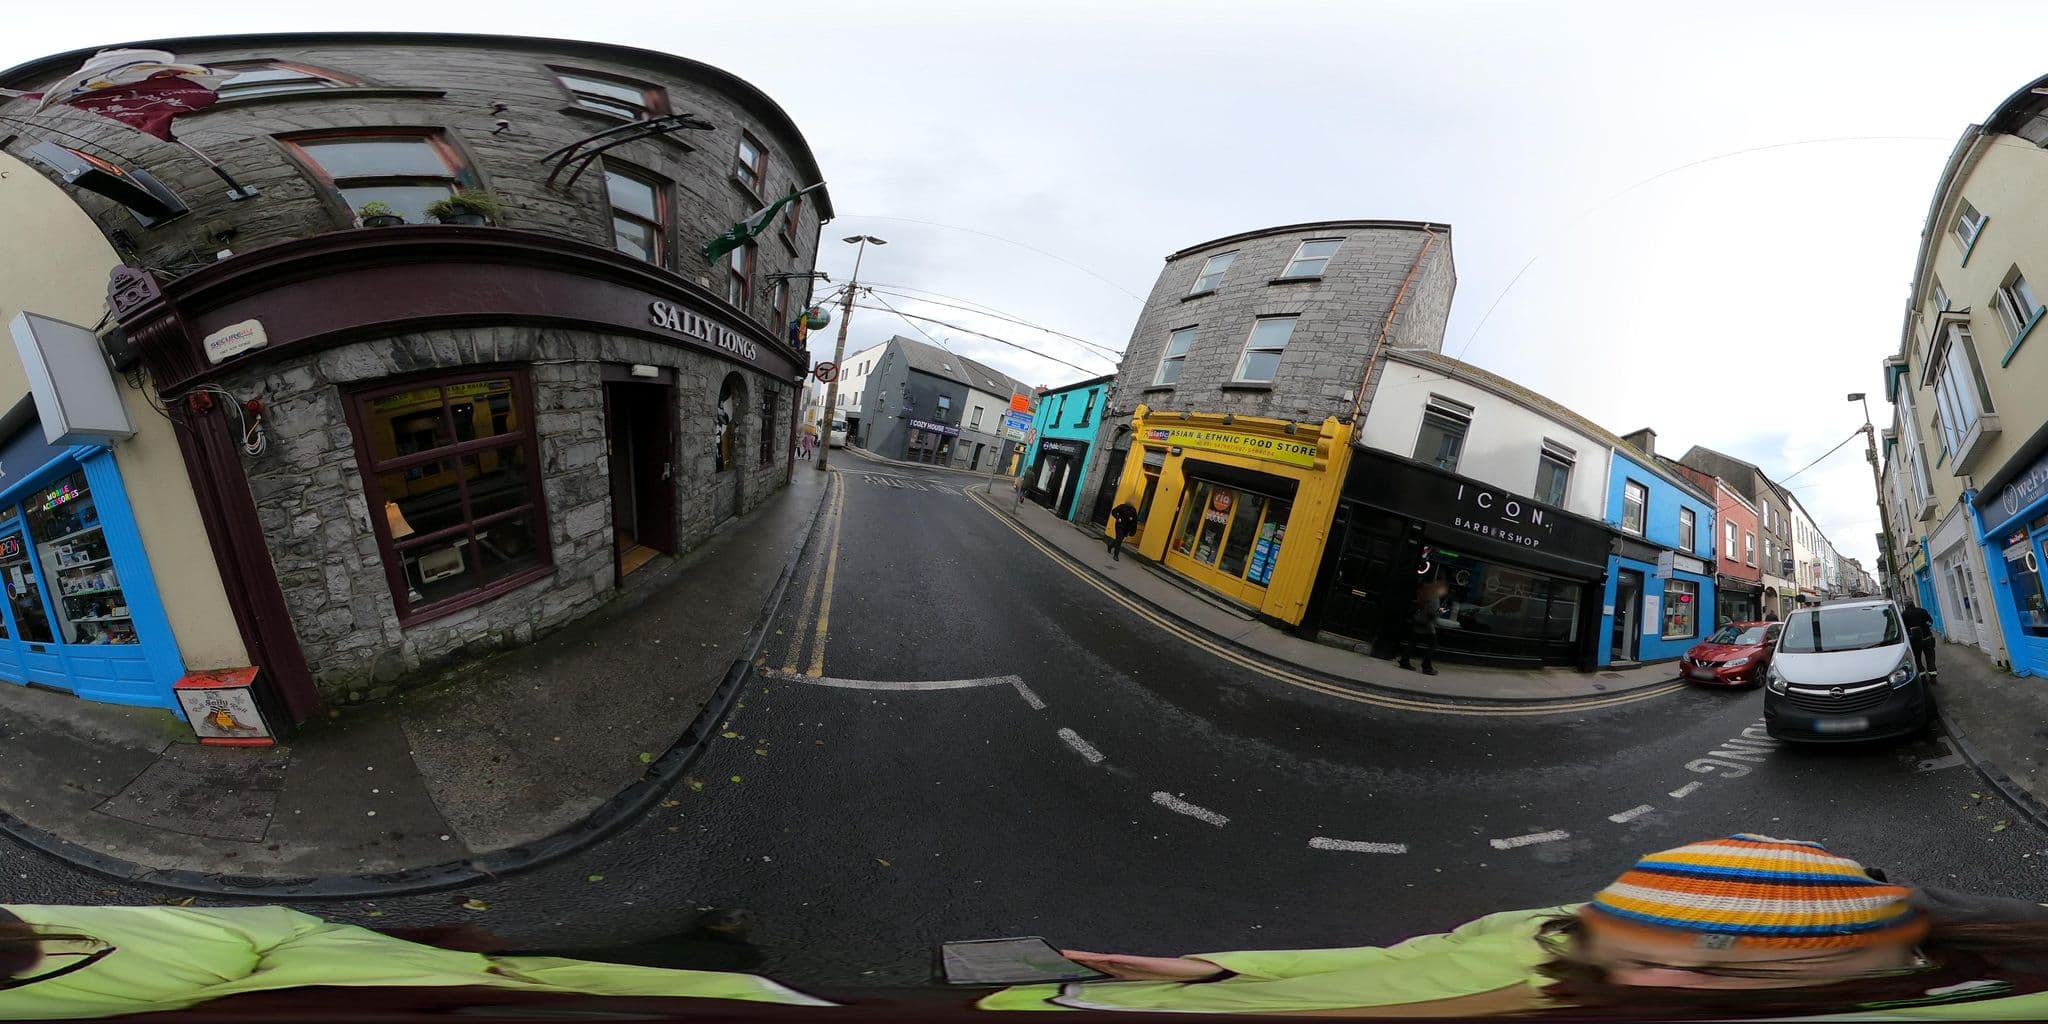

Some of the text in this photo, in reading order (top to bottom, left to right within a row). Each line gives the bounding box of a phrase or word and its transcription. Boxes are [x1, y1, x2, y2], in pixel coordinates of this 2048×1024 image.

[652, 301, 757, 361] SALLY LONGS
[913, 420, 928, 428] COZY
[927, 422, 945, 432] HOUSE
[1170, 430, 1195, 438] ASIAN
[1205, 432, 1240, 444] ETHNIC
[1243, 437, 1273, 449] FOOD
[1276, 442, 1316, 457] STORE
[47, 484, 70, 501] MOBILE
[2017, 469, 2048, 499] weFI
[42, 489, 79, 512] ACCESSORIES
[1457, 484, 1543, 526] ICON
[1455, 517, 1539, 548] BARBERSHOP
